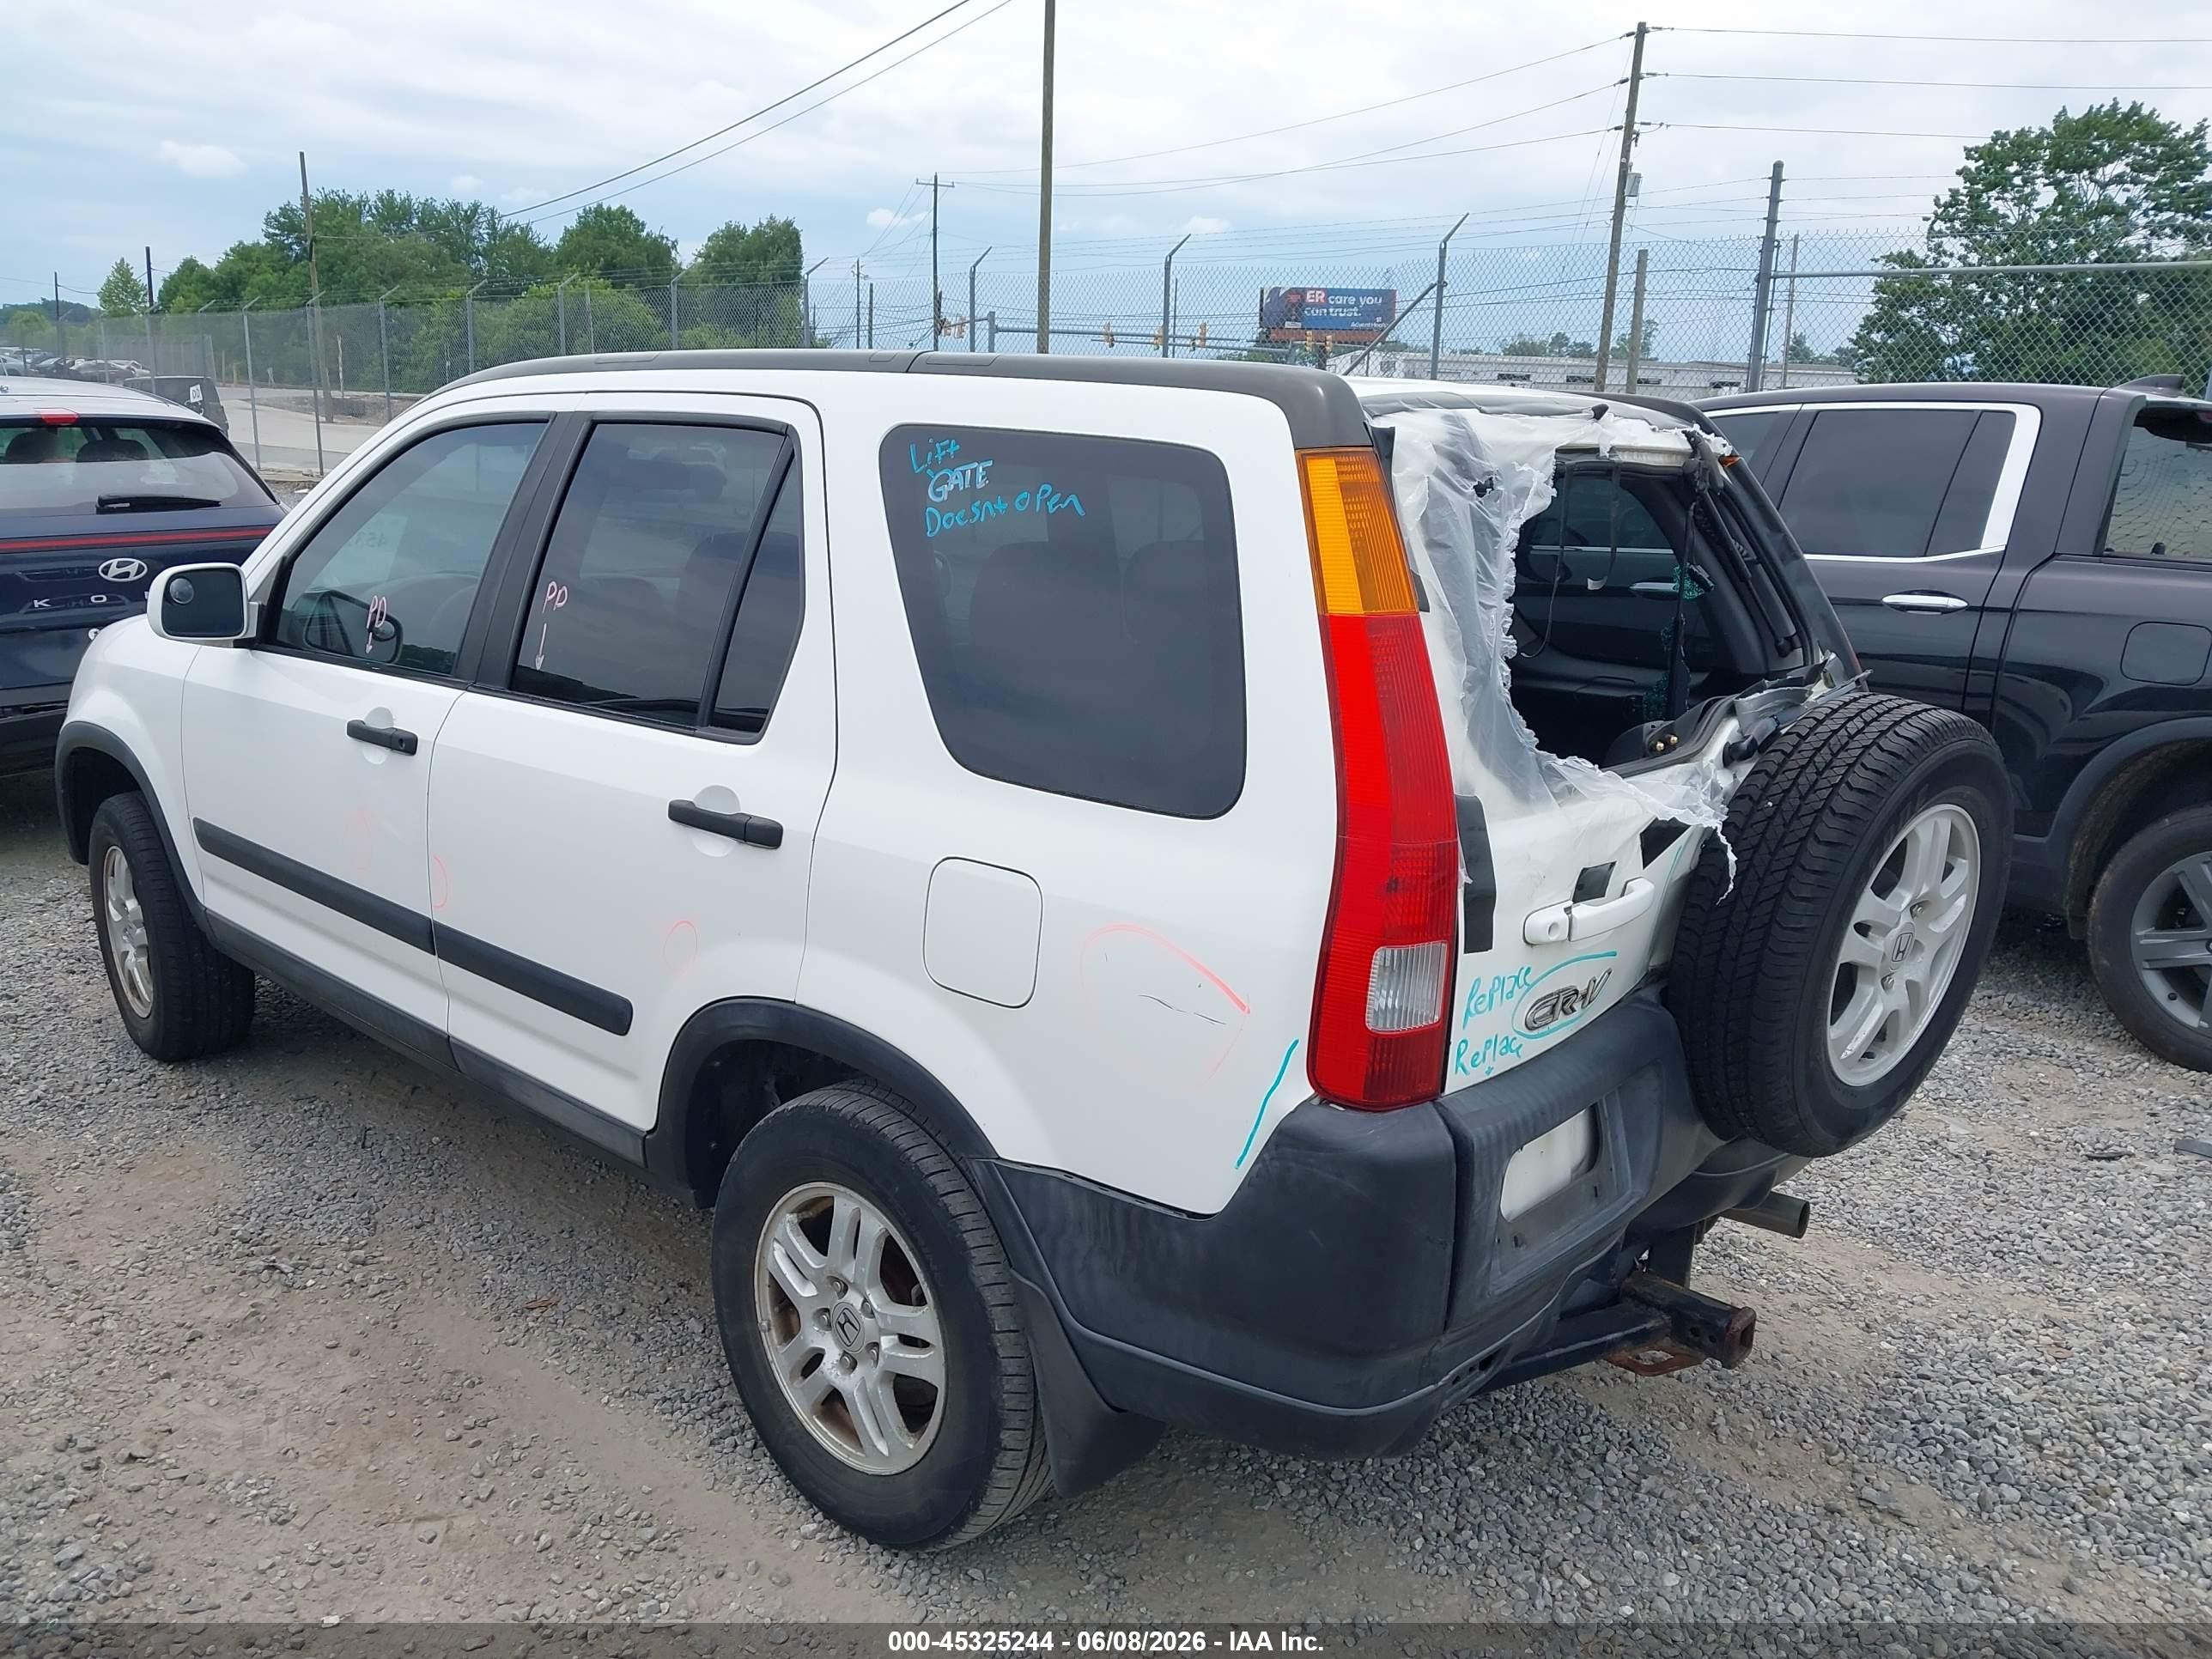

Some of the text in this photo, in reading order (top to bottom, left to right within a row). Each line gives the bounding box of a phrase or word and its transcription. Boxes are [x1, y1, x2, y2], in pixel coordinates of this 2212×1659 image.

[1304, 307, 1328, 316] can
[1306, 289, 1326, 303] ER
[1328, 295, 1356, 305] care
[1359, 295, 1382, 307] you
[927, 460, 993, 502] GATE
[1524, 968, 1613, 1031] CR-V
